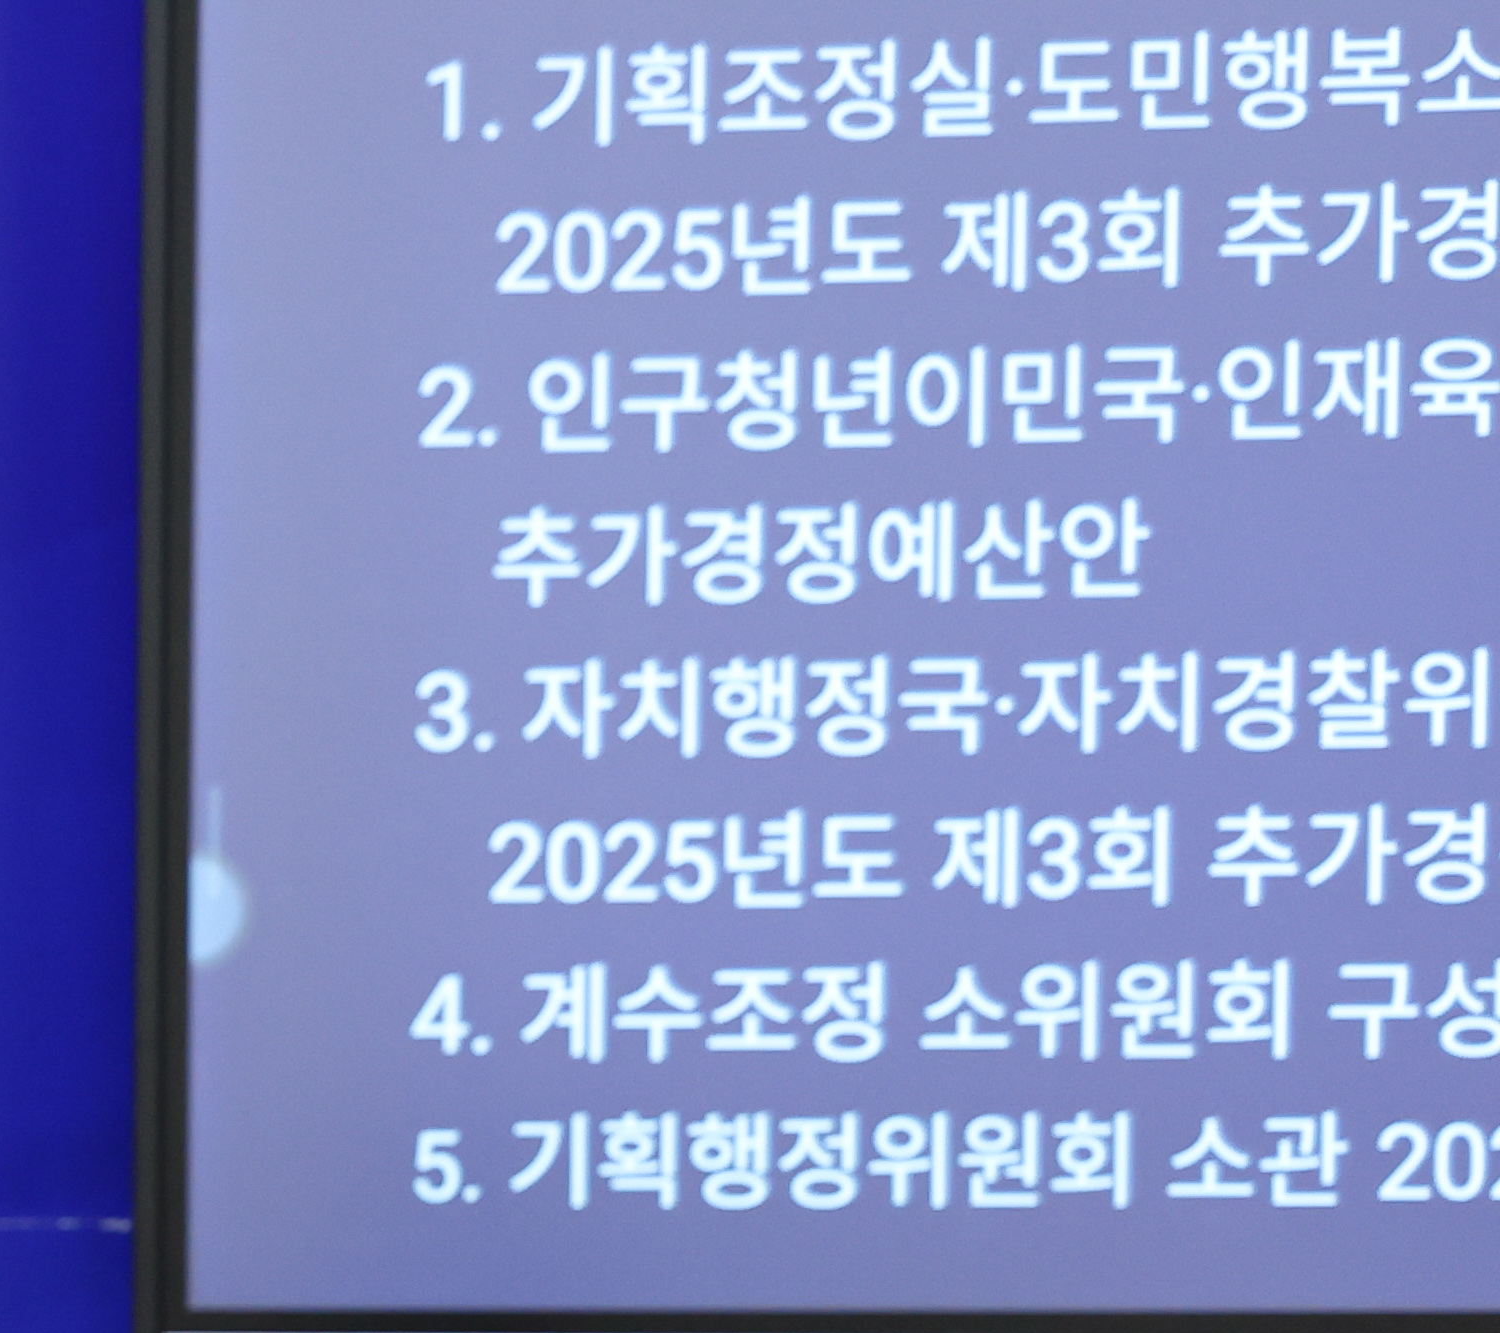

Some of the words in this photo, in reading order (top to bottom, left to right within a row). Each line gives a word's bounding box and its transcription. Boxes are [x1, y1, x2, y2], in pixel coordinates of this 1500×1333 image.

[425, 60, 502, 143] 1.
[494, 194, 913, 297] 2025년도
[941, 185, 1182, 293] 제3회
[1218, 177, 1500, 288] 추가경
[418, 365, 498, 449] 2.
[492, 496, 1152, 609] 추가경정예산안
[414, 669, 494, 754] 3.
[488, 808, 904, 910] 2025년도
[932, 805, 1172, 910] 제3회
[1207, 801, 1488, 908] 추가경
[410, 974, 491, 1055] 4.
[521, 960, 885, 1064] 계수조정
[920, 958, 1291, 1062] 소위원회
[415, 1129, 480, 1203] 5.
[511, 1111, 1131, 1210] 기획행정위원회
[1167, 1109, 1350, 1208] 소관
[1377, 1121, 1500, 1202] 20
